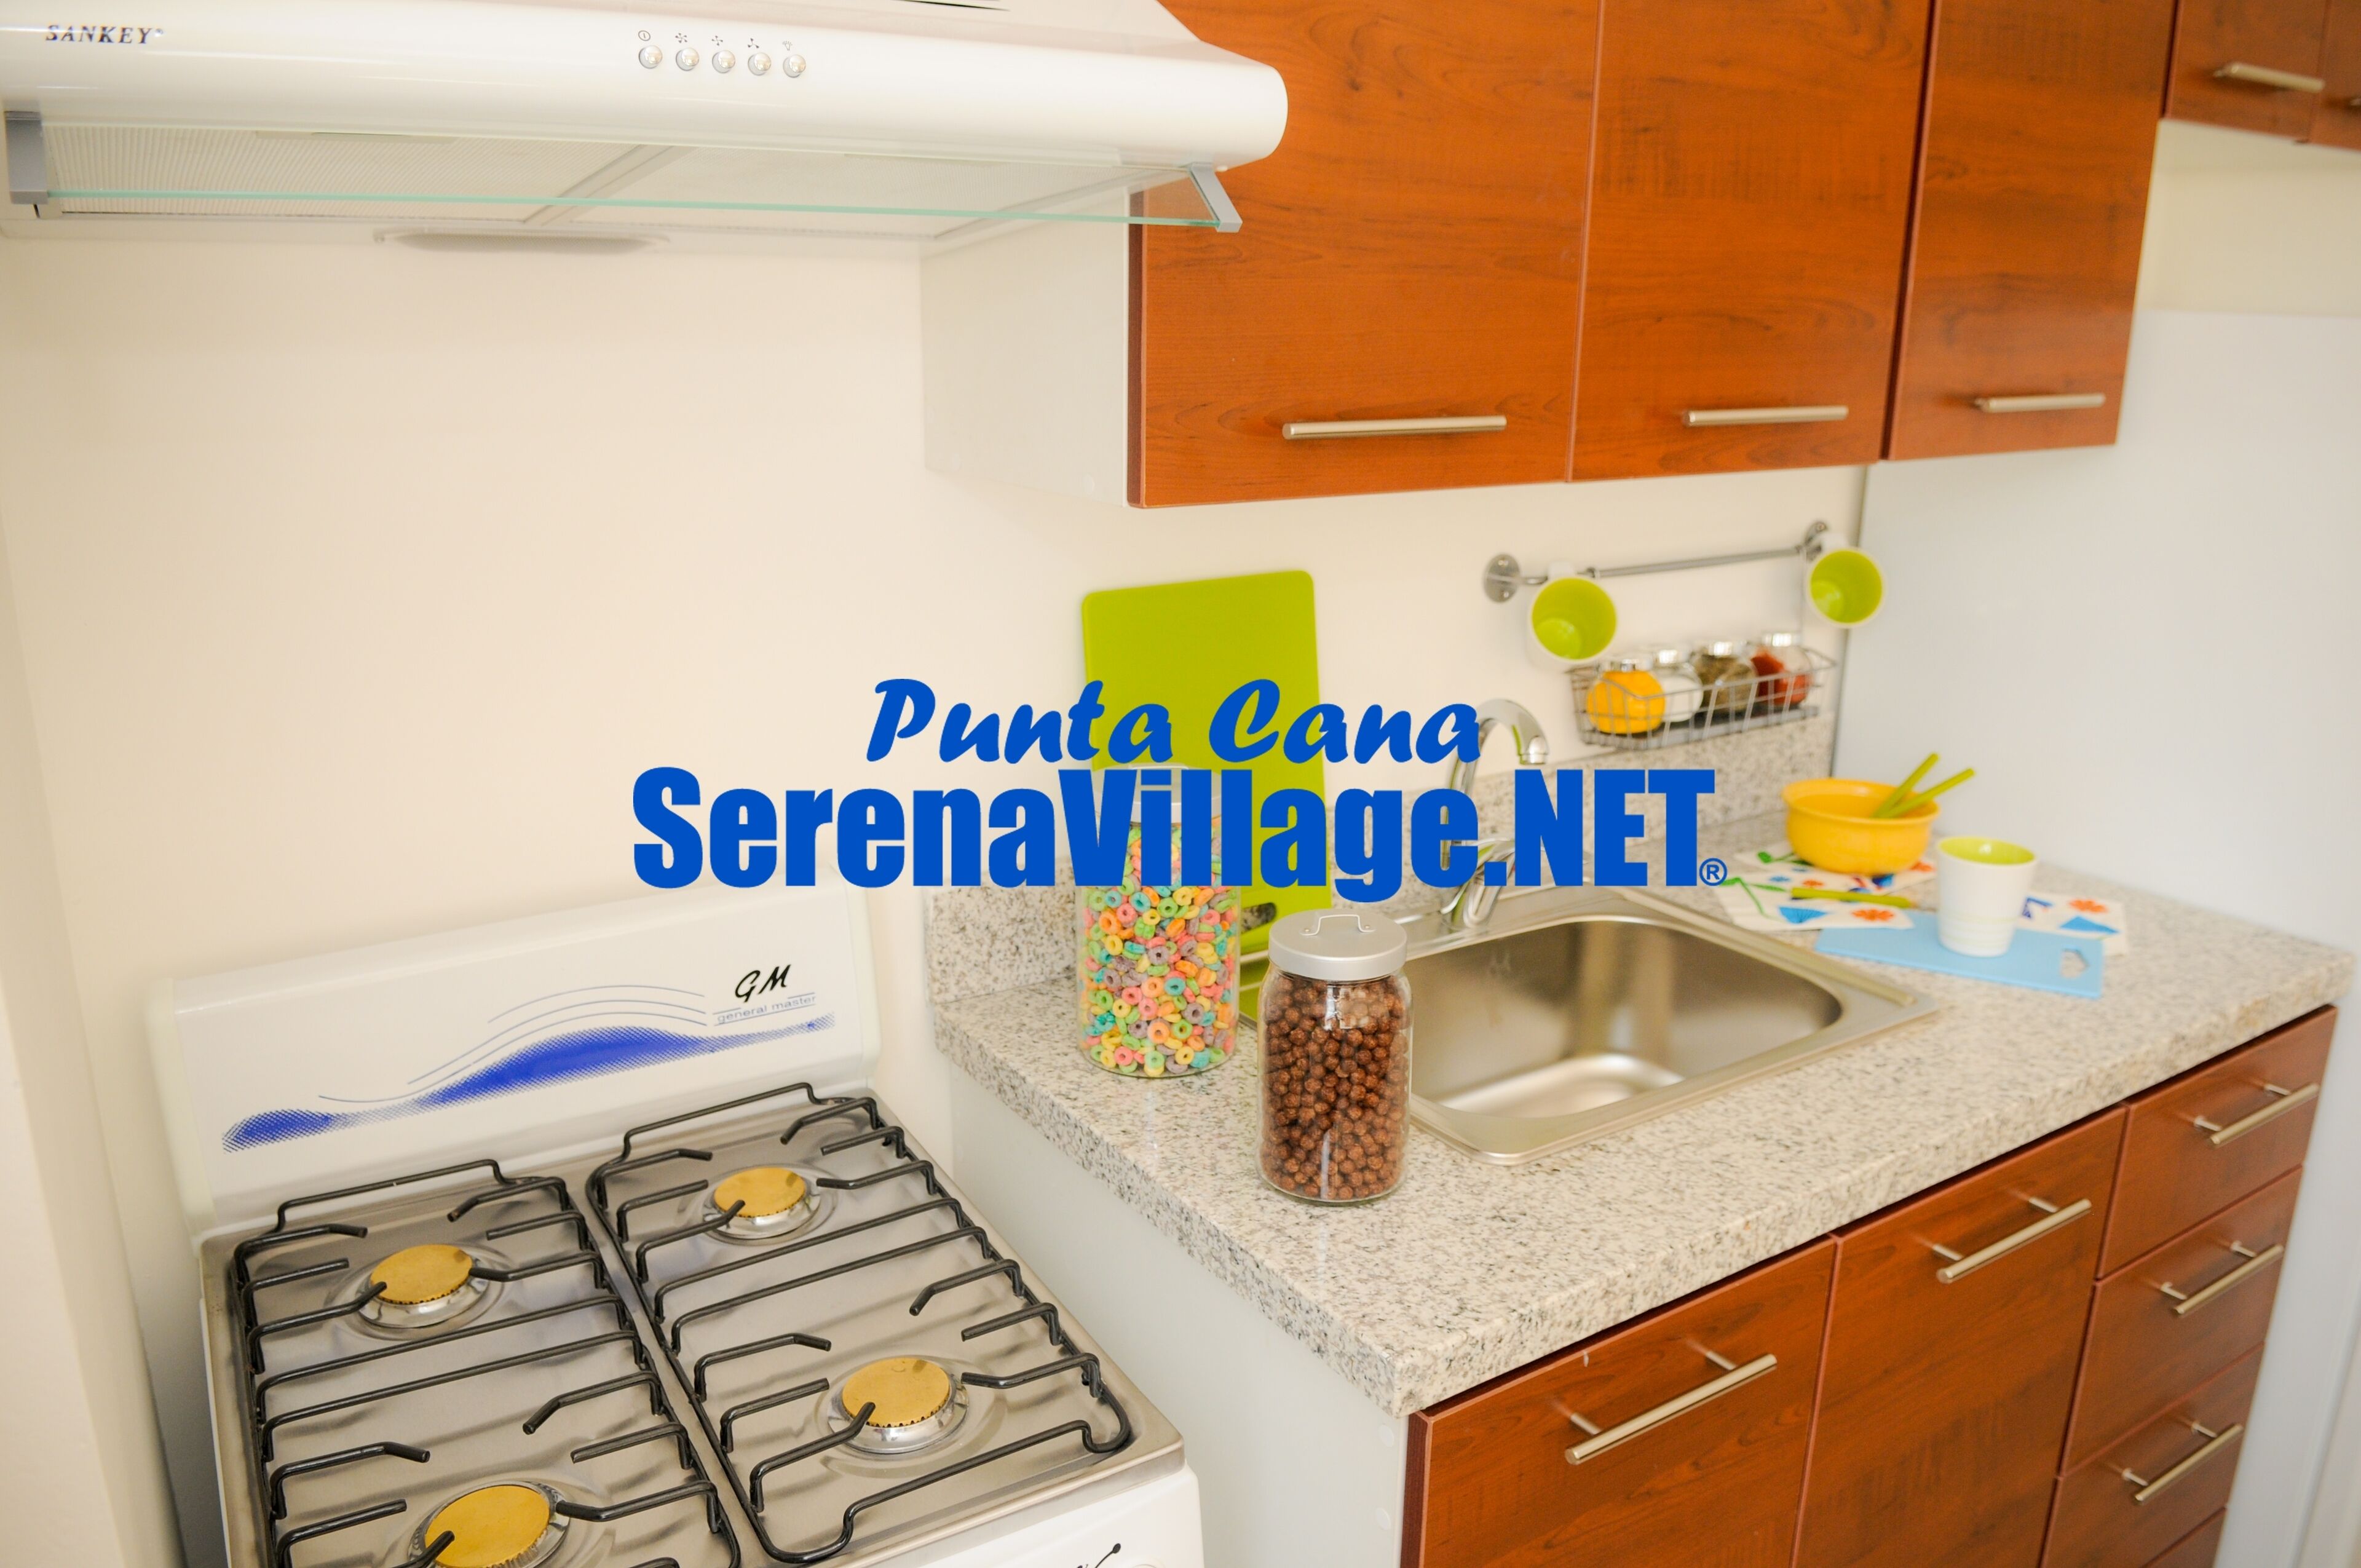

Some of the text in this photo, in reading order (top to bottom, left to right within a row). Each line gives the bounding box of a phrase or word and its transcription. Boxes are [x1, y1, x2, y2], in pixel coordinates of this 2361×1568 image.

[734, 964, 792, 1004] GM
[716, 995, 817, 1025] general master
